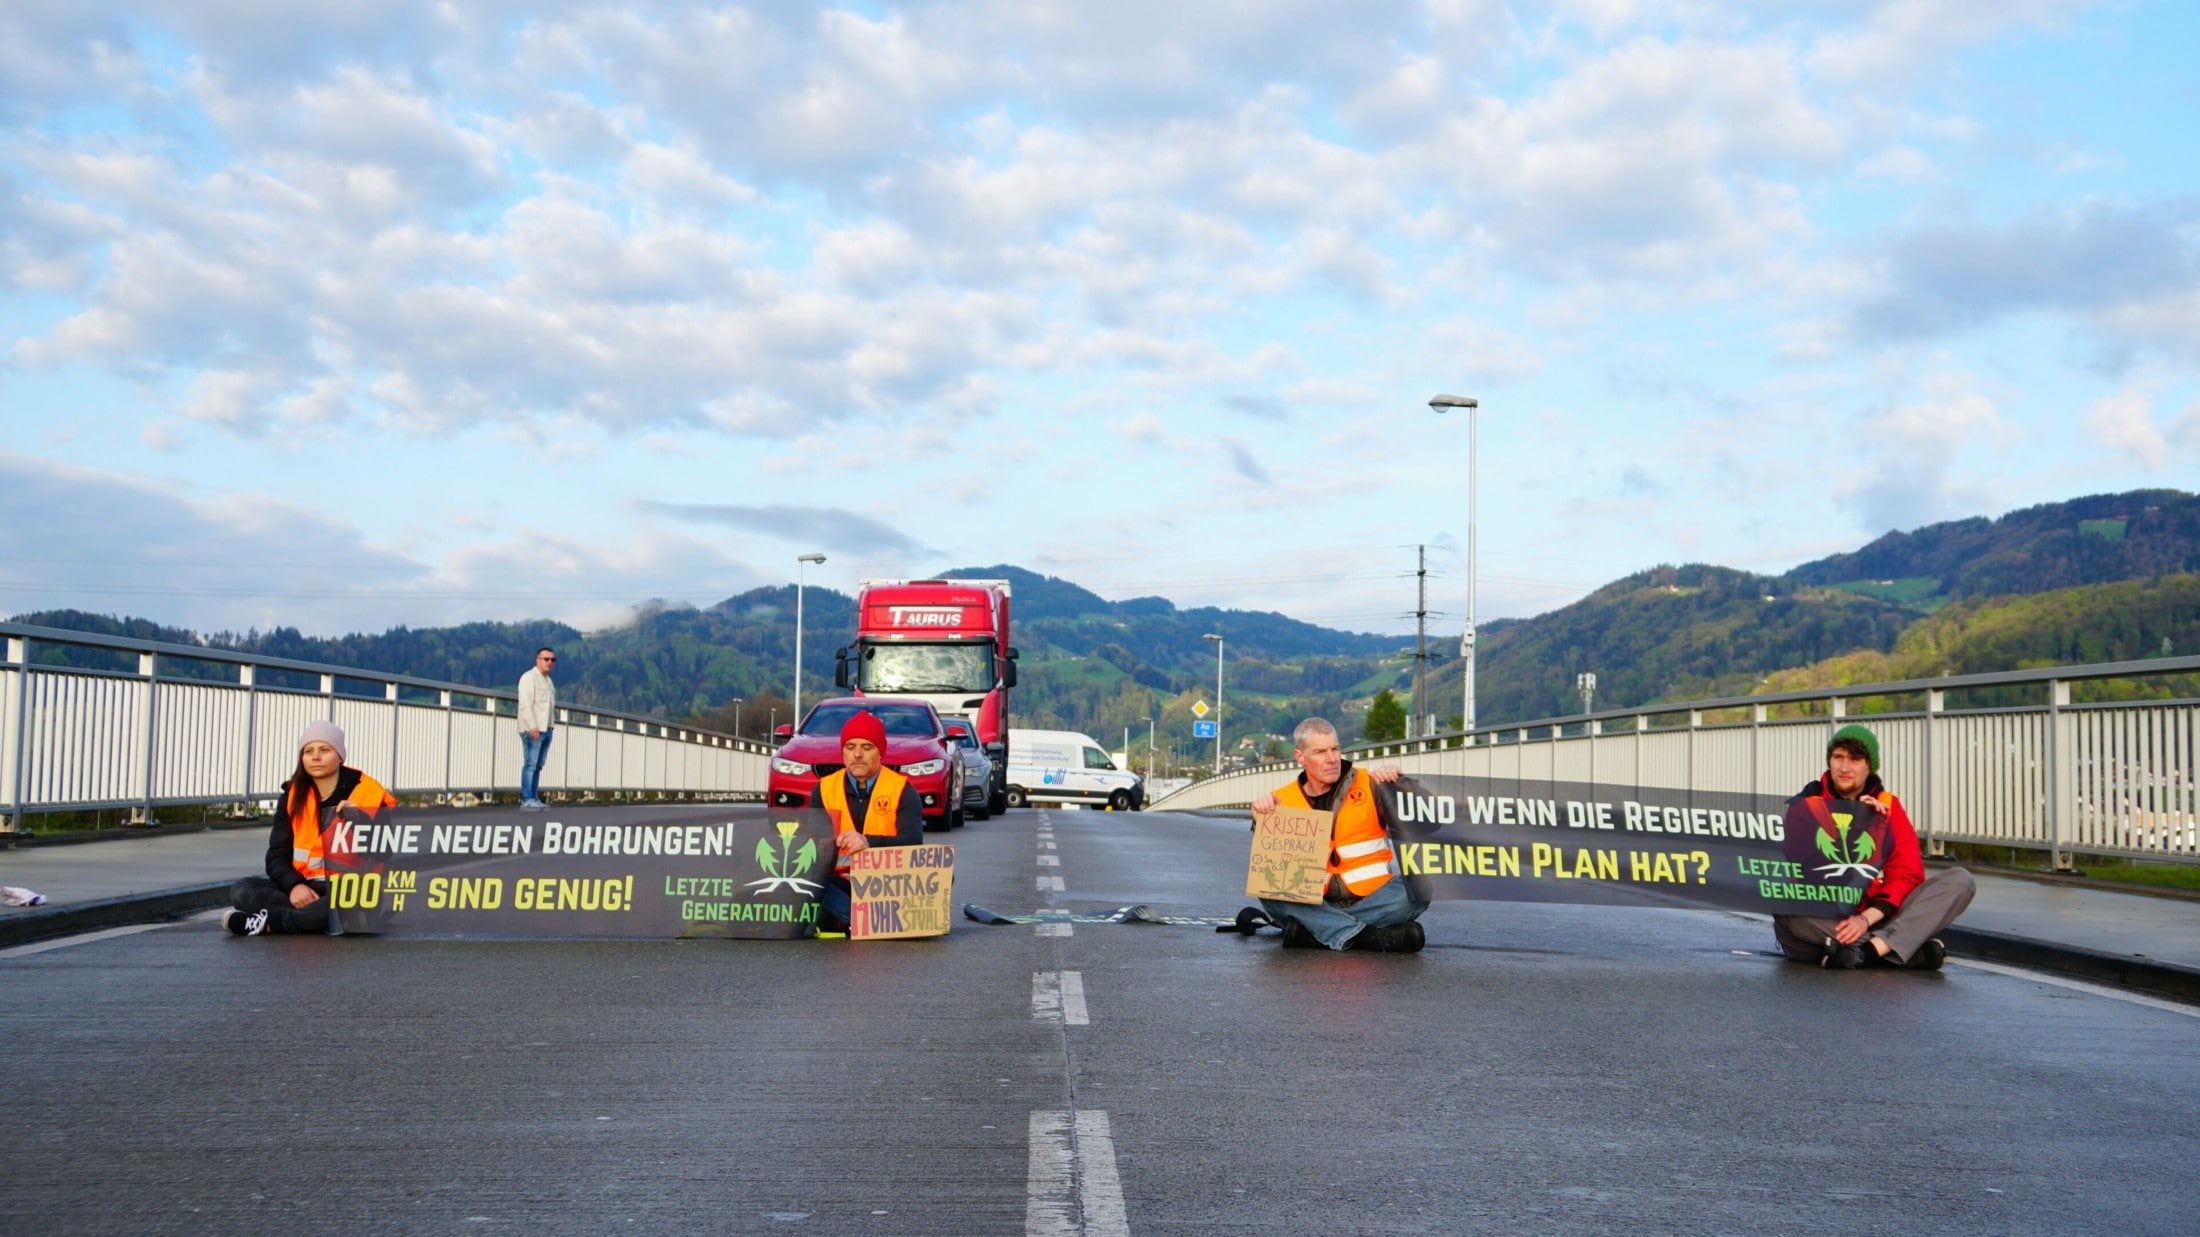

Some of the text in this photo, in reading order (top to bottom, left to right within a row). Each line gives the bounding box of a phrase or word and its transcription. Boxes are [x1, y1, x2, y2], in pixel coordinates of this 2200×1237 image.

[888, 606, 964, 627] TAURUS
[1260, 811, 1325, 837] KRISEN-
[1396, 791, 1785, 842] UND WENN DIE REGIERUNG
[331, 821, 734, 856] KEINE NEUEN BOHRUNGEN!
[1261, 835, 1316, 854] GESPRÄCH
[851, 847, 954, 870] HEUTE ABEND
[1400, 842, 1711, 885] KEINEN PLAN HAT?
[1738, 855, 1805, 879] LETZTE
[329, 870, 634, 912] 100 KM H SIND GENUG!
[665, 875, 734, 897] LETZTE
[850, 871, 940, 900] VORTRAG
[1759, 878, 1863, 906] GENERATION
[682, 899, 820, 923] GENERATION.AT
[901, 895, 936, 910] ALTE
[869, 900, 904, 934] UHR
